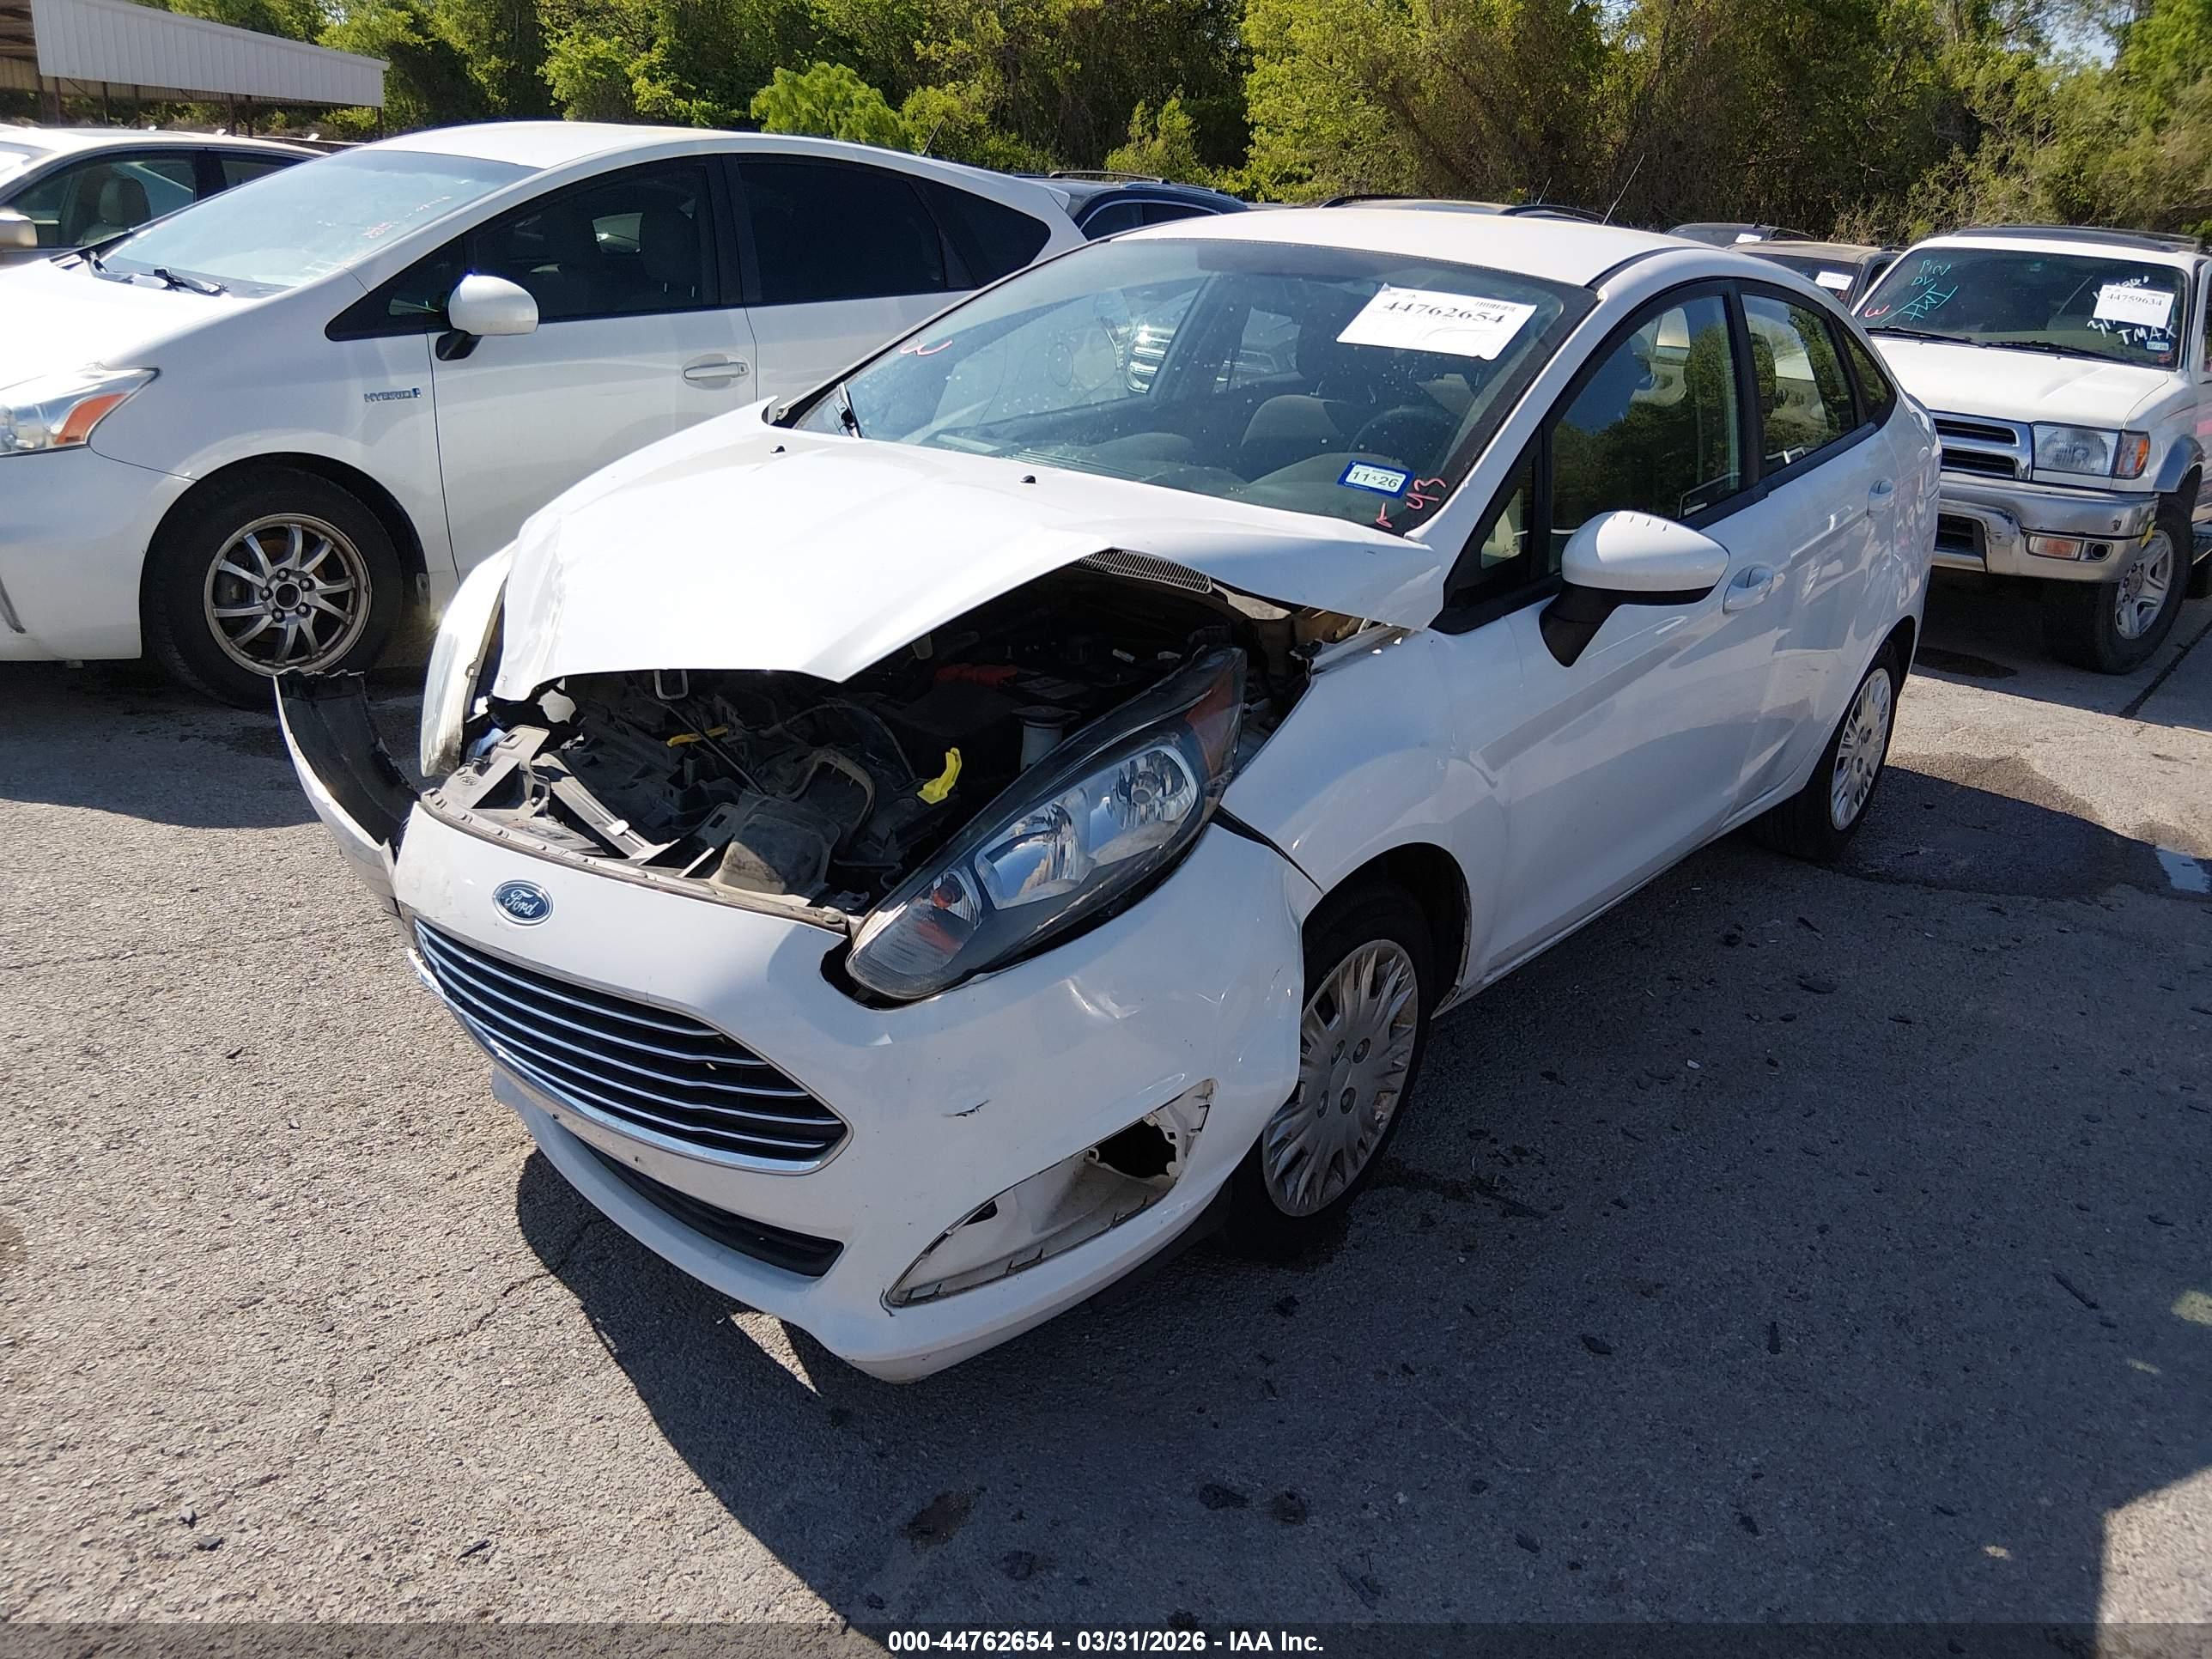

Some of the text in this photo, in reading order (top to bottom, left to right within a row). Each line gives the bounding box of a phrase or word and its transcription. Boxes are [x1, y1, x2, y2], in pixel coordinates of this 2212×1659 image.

[1382, 301, 1505, 325] 44762654
[2117, 325, 2177, 345] TMAX
[504, 889, 539, 916] Ford
